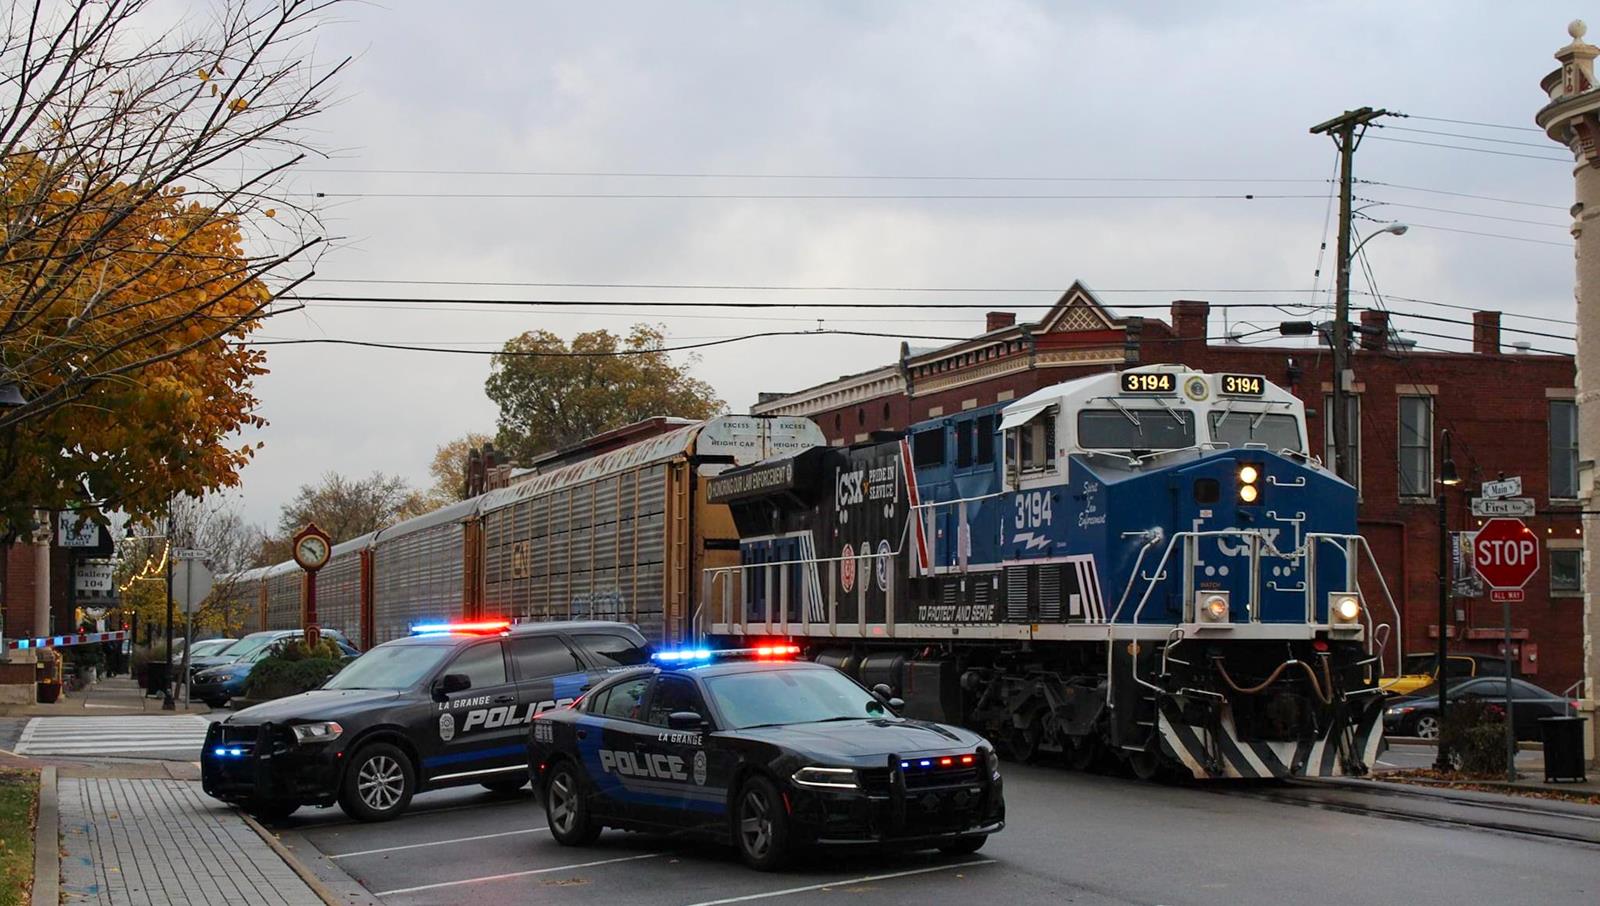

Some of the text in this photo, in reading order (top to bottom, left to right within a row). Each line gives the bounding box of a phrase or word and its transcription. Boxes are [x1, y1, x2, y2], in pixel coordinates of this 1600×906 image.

[1128, 375, 1169, 390] 3194
[1226, 377, 1259, 392] 3194
[713, 466, 786, 497] HONORING OUR LAW ENFORCEMENT
[868, 466, 895, 483] PRIDE IN
[839, 470, 864, 506] CSX
[868, 483, 893, 500] SERVICE
[1491, 484, 1508, 494] Main
[1015, 490, 1052, 530] 3194
[1485, 502, 1508, 512] First
[1217, 527, 1280, 557] CSX
[1478, 540, 1534, 566] STOP
[77, 570, 111, 579] Gallery
[84, 580, 103, 588] 104
[918, 604, 995, 621] TO PROTECT AND SERVE
[438, 696, 491, 710] LA GRANGE
[534, 725, 554, 743] 911
[658, 731, 703, 745] LA GRANGE
[599, 749, 688, 780] POLICE
